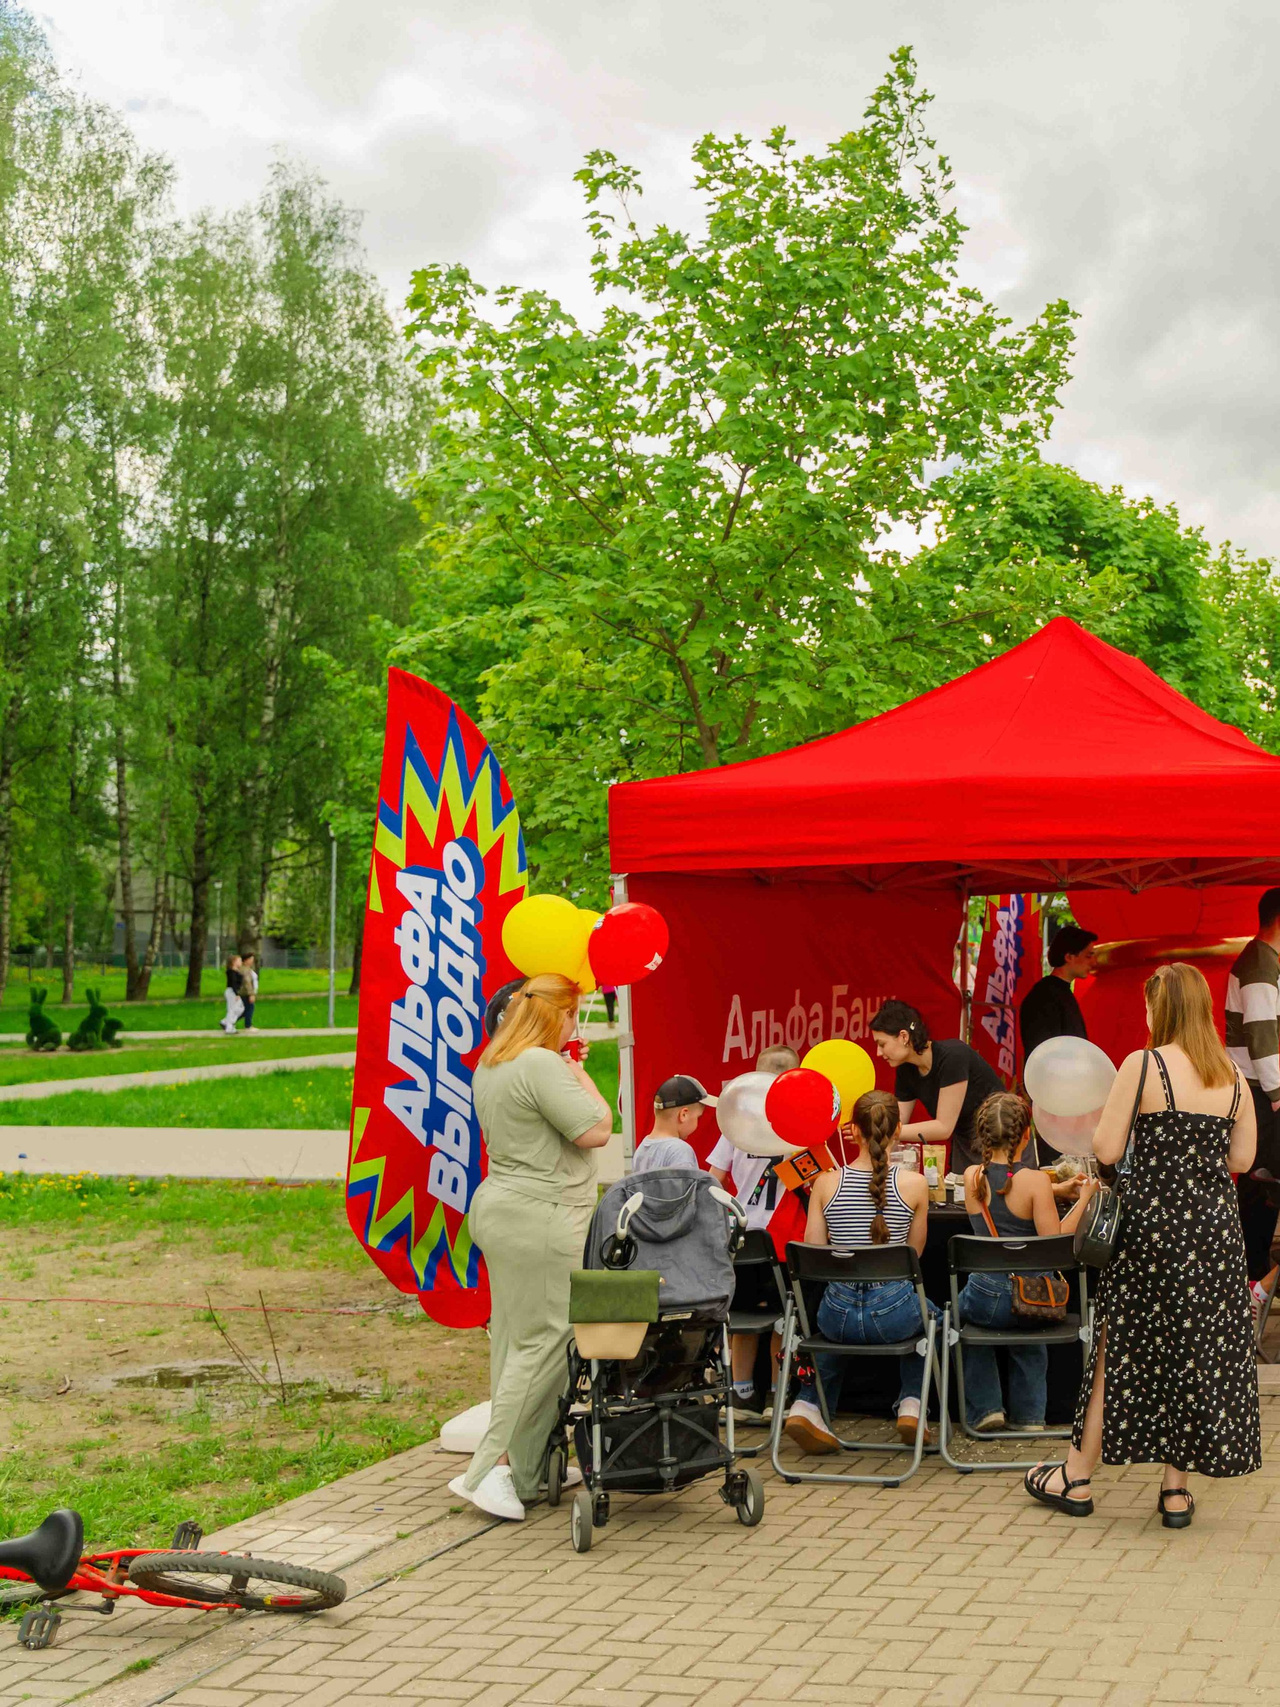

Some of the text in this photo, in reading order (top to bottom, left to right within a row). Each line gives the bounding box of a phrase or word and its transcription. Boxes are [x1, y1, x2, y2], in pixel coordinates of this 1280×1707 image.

[384, 867, 439, 1146] АЛЬФА
[427, 837, 483, 1213] ВЫГОДНО
[722, 984, 896, 1063] Альфа Бан
[981, 911, 1010, 1044] АЛЬФА
